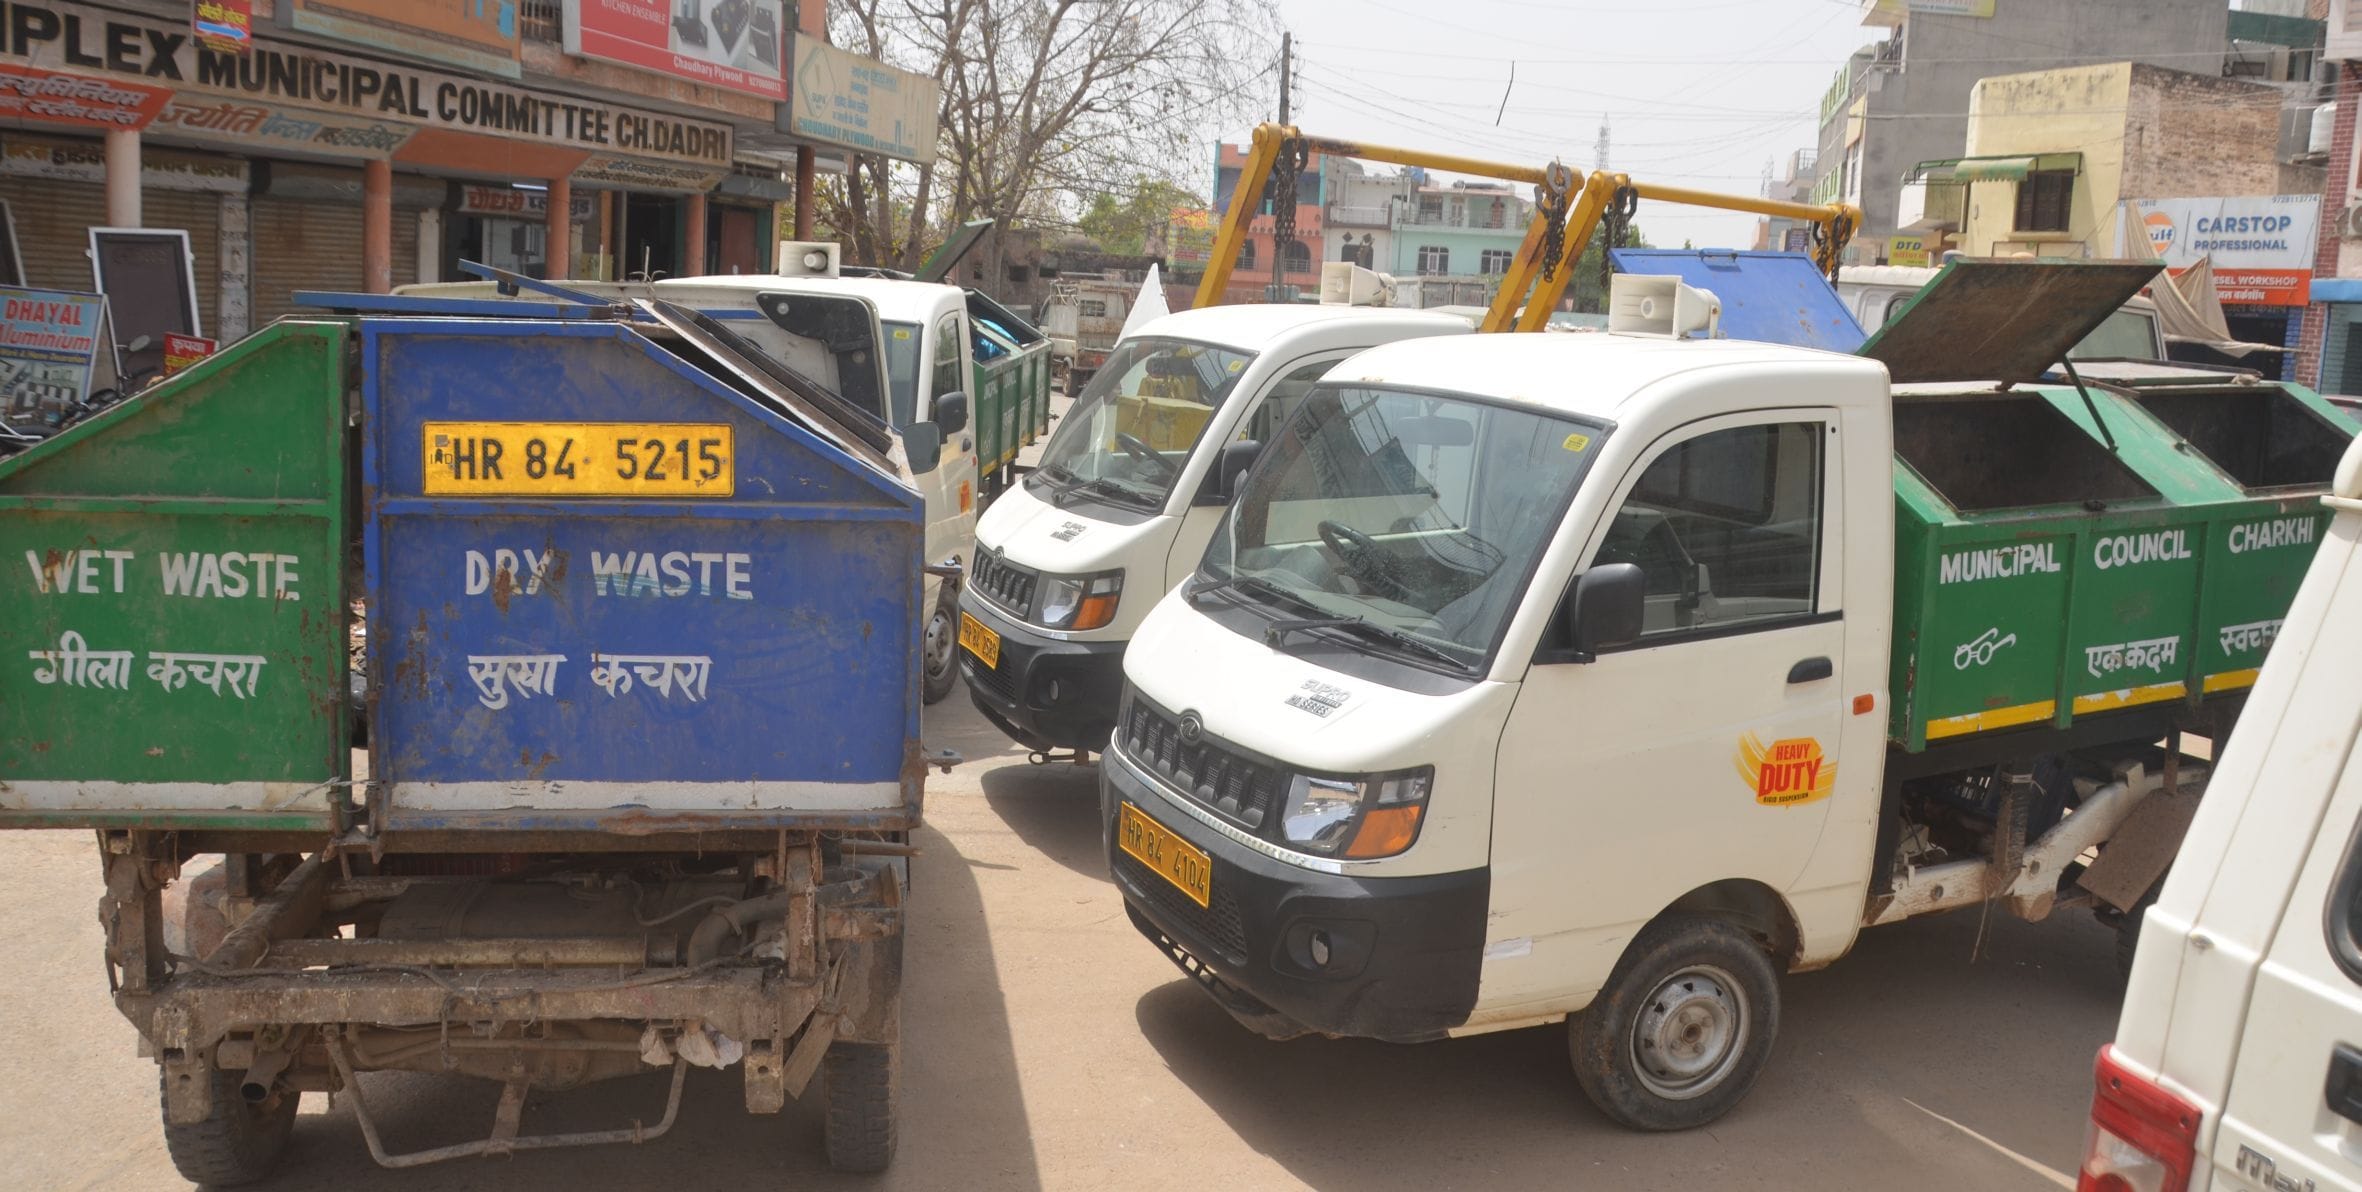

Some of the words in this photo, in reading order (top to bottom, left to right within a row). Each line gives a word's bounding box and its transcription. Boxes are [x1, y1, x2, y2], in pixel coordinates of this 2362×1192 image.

[673, 55, 713, 79] Chaudhary
[713, 65, 744, 84] Plywood
[199, 50, 428, 118] MUNICIPAL
[437, 83, 608, 144] COMMITTEE
[616, 113, 727, 160] CH.DADRI
[2194, 240, 2288, 250] PROFESSIONAL
[2197, 216, 2291, 233] CARSTOP
[2212, 276, 2236, 285] ESEL
[2238, 276, 2298, 286] WORKSHOP
[5, 299, 82, 326] DHAYAL
[453, 438, 504, 480] HR
[525, 438, 576, 480] 84
[616, 438, 722, 481] 5215
[1939, 542, 2061, 585] MUNICIPAL
[2094, 529, 2192, 570] COUNCIL
[2228, 516, 2314, 554] CHARKHI
[26, 550, 134, 594] WET
[160, 551, 300, 600] WASTE
[591, 550, 754, 600] WASTE
[29, 630, 135, 690] गीला
[147, 651, 268, 700] कचरा
[591, 653, 713, 703] कचरा
[1776, 744, 1811, 761] HEAVY
[1758, 754, 1825, 798] DUTY
[1128, 815, 1144, 851] HR
[1147, 828, 1164, 865] 84
[1173, 848, 1206, 895] 4104
